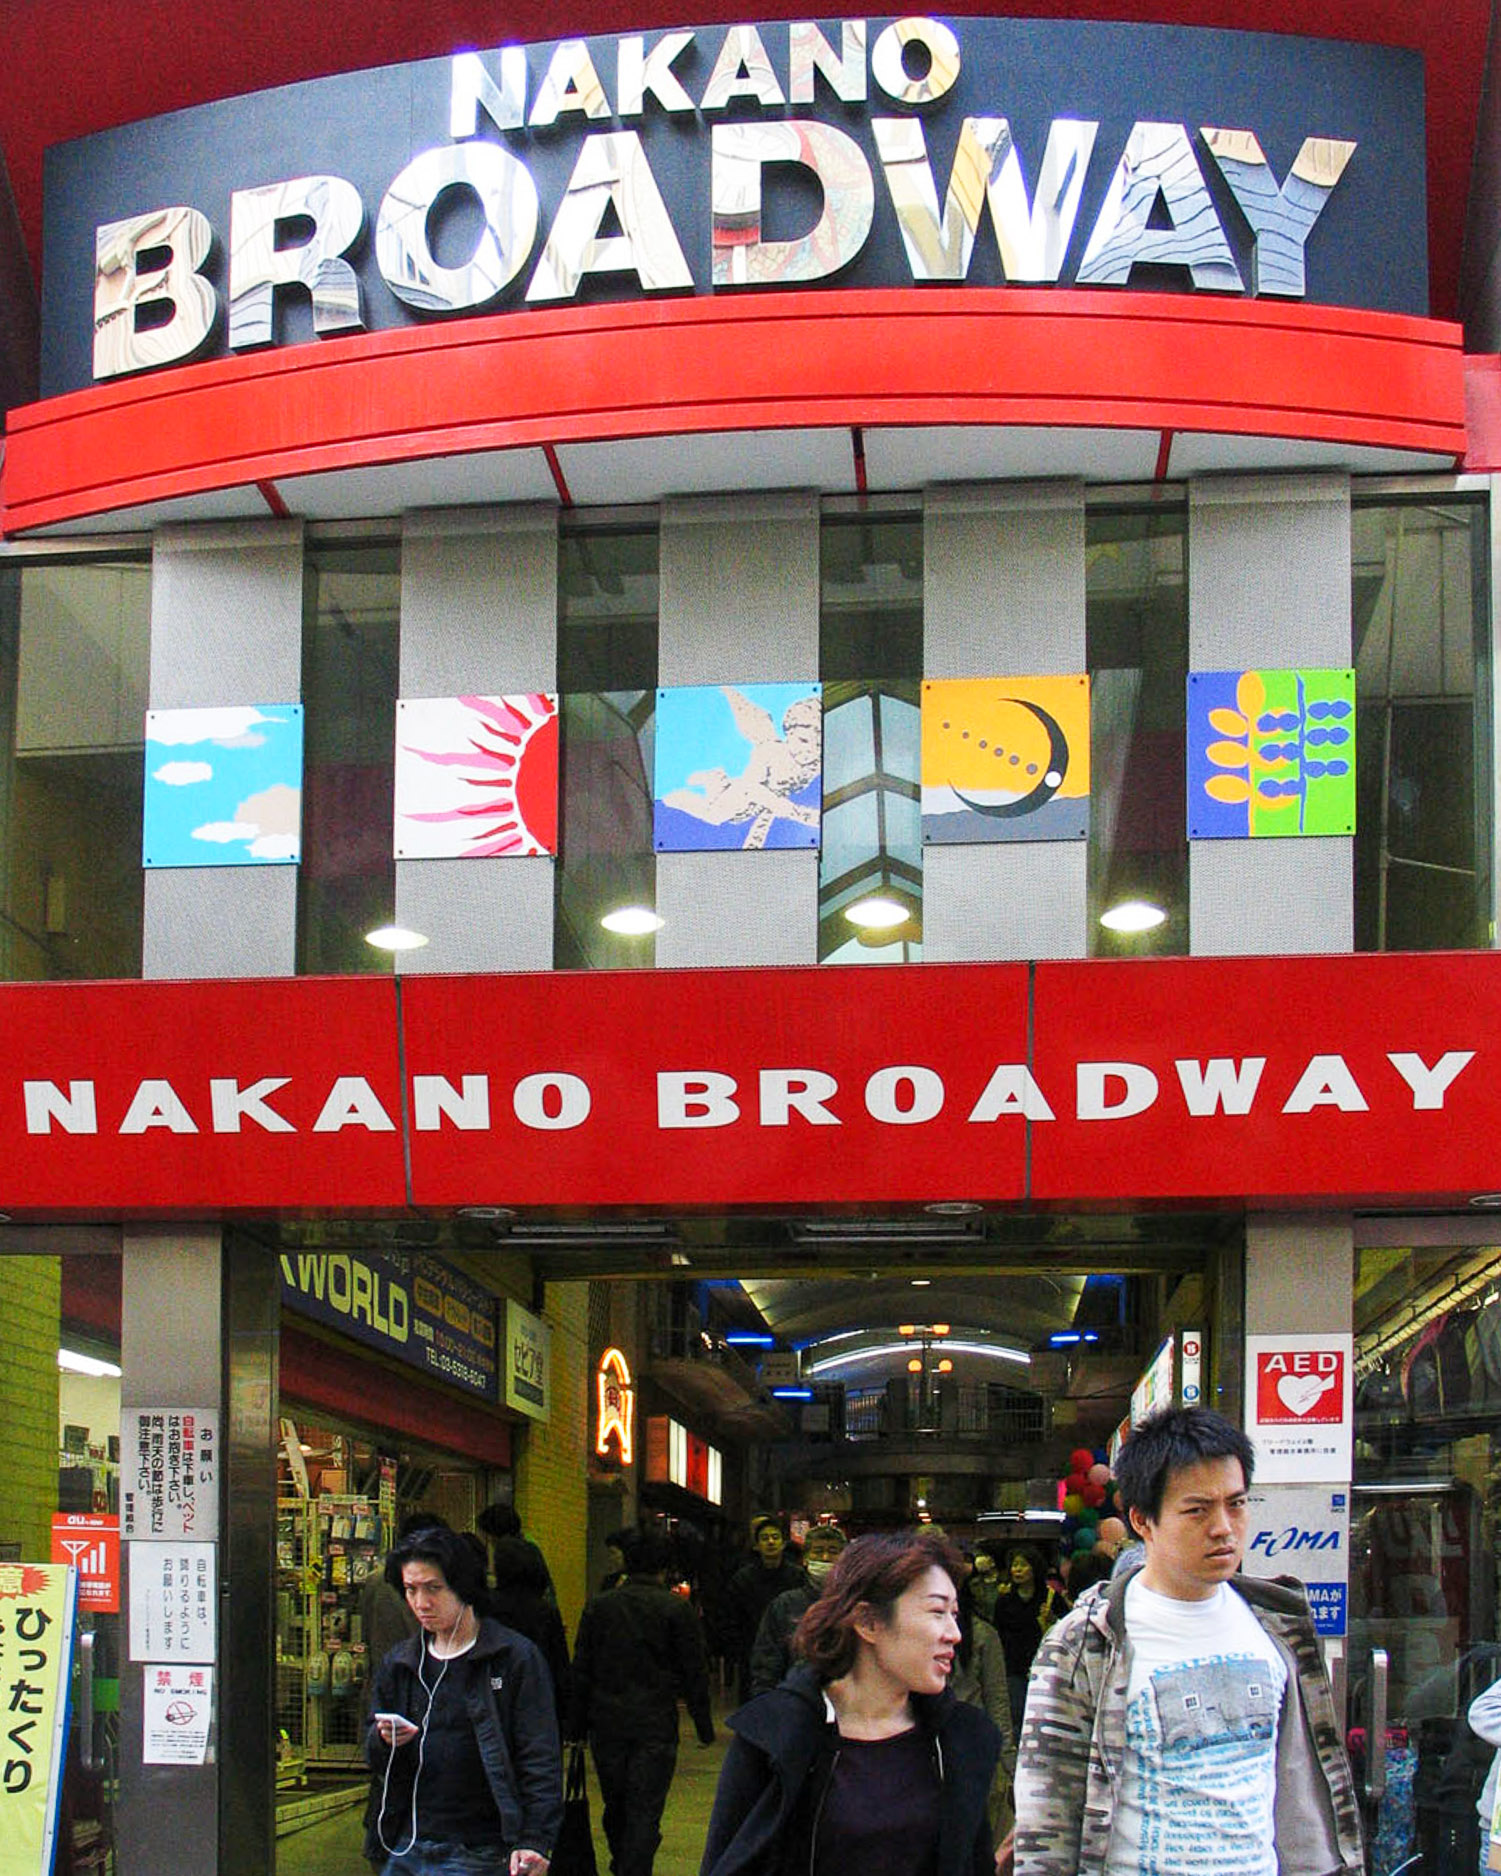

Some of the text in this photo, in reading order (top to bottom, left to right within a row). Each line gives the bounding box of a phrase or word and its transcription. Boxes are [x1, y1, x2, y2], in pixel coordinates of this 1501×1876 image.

[449, 16, 961, 138] NAKANO
[93, 117, 1358, 380] BROADWAY
[23, 1051, 1476, 1135] NAKANO BROADWAY
[1264, 1353, 1338, 1373] AED
[200, 1428, 213, 1483] お願い
[1250, 1527, 1340, 1558] FOMA
[162, 1557, 174, 1651] お願いします
[4, 1607, 53, 1793] ひったくり
[156, 1670, 205, 1687] 禁煙
